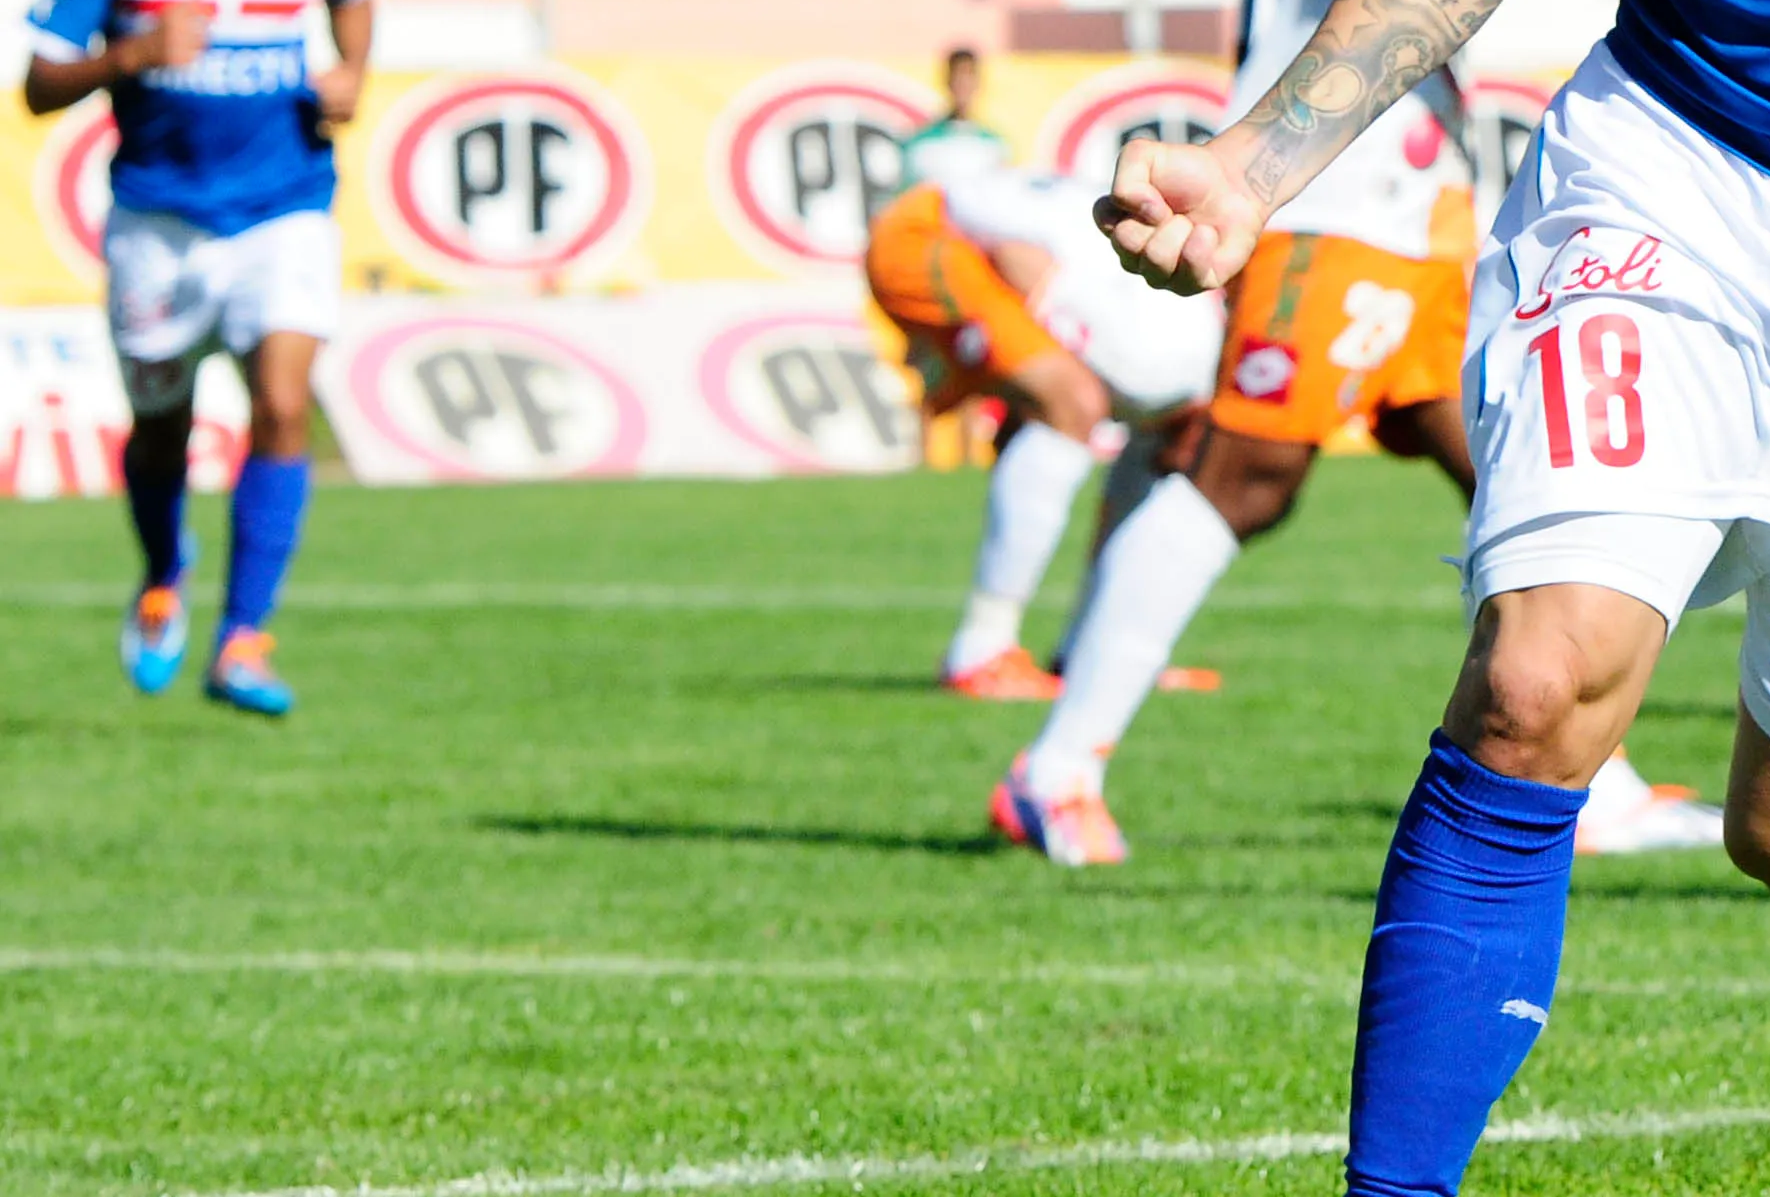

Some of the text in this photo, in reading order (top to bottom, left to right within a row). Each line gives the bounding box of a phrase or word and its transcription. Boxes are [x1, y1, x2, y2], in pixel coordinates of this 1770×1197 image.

[454, 118, 570, 234] PF
[1515, 226, 1662, 320] Stoli
[415, 347, 568, 457] PF
[1528, 313, 1645, 469] 18
